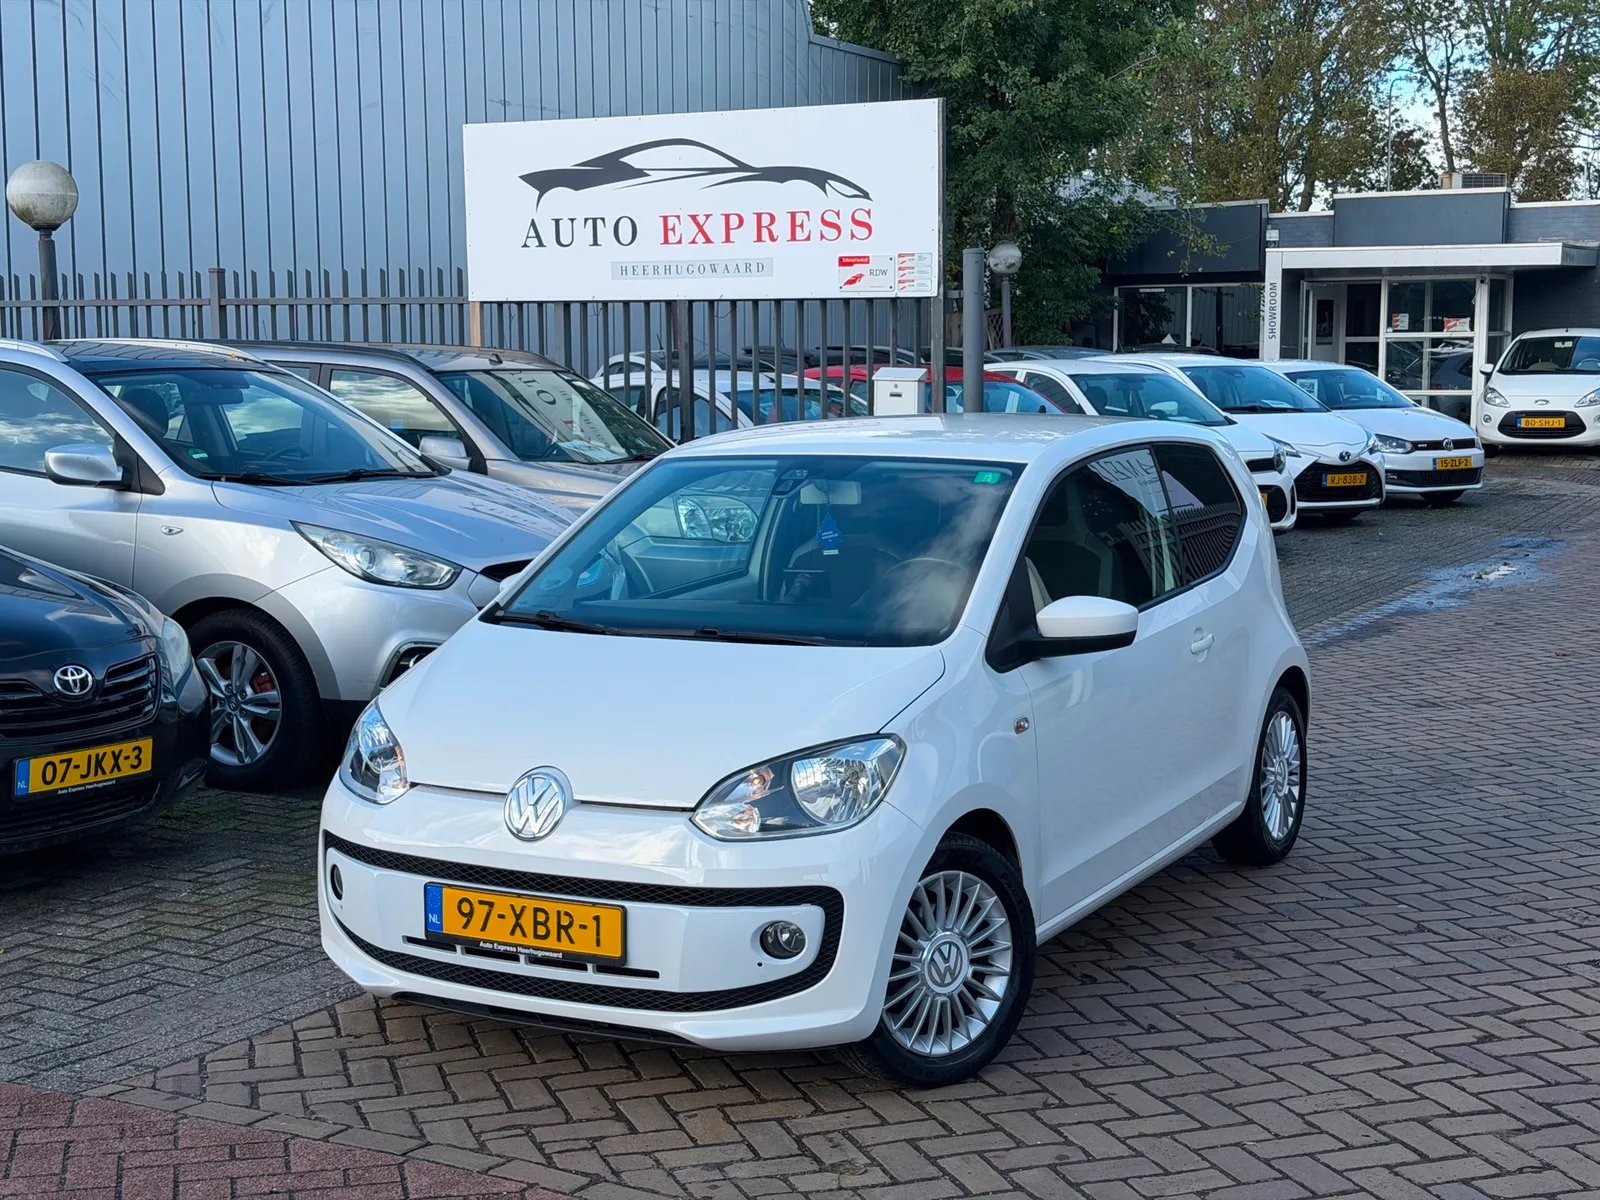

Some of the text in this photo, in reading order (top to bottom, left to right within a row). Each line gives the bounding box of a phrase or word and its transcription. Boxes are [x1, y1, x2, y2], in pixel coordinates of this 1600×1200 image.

[521, 208, 873, 248] AUTO EXPRESS
[620, 262, 765, 276] HEERHUGOWAARD
[869, 269, 888, 277] RDW
[1268, 282, 1278, 340] SHOWROOM
[1524, 419, 1561, 427] 80-SHJ-1
[42, 746, 142, 785] 07-JKX-3
[17, 781, 28, 789] NL
[428, 912, 441, 925] NL
[457, 897, 601, 947] 97-XBR-1
[479, 941, 563, 959] Auto Express Heerhugowaard
